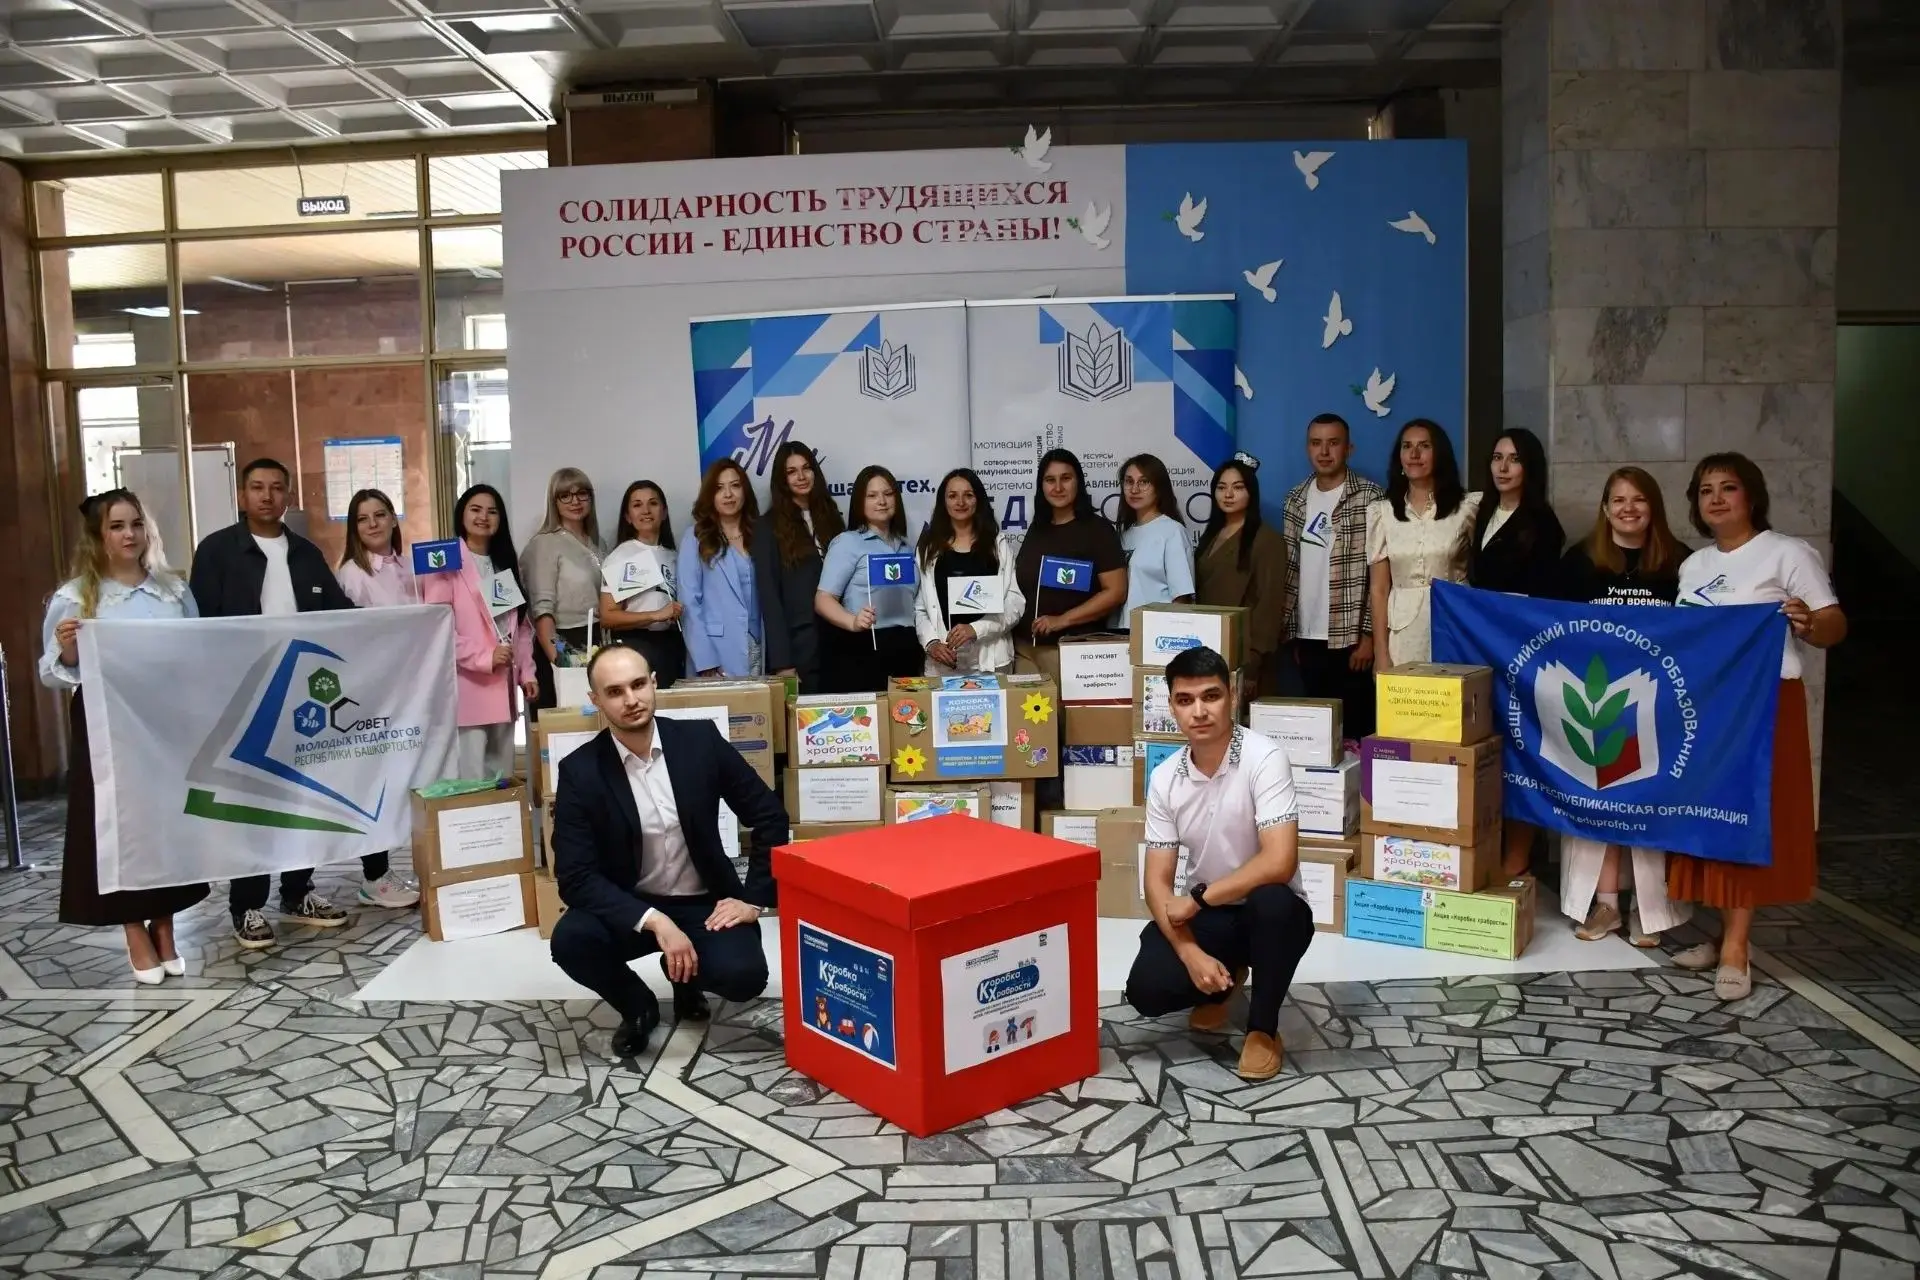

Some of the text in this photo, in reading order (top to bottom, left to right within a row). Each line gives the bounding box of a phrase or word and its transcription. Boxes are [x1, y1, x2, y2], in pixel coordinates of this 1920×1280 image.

[302, 199, 346, 212] ВЫХОД
[559, 181, 1069, 225] СОЛИДАРНОСТЬ ТРУДЯЩИХСЯ
[559, 231, 695, 259] РОССИИ
[722, 221, 903, 257] ЕДИНСТВО
[912, 216, 1061, 244] СТРАНЫ!
[972, 468, 1033, 478] оммуникация
[983, 459, 1033, 467] сотворчество
[1607, 586, 1653, 597] Учитель
[1507, 619, 1698, 779] ОБЩЕРССИЙСКИЙ ПРОФСОЮЗ ОБРАЗОВАНИЯ
[294, 738, 423, 766] РЕСПУБЛИКИ БАШКОРТОСТАН
[295, 726, 421, 754] МОЛОДЫХ ПЕДАГОГОВ
[807, 745, 873, 756] храбрости
[1503, 771, 1749, 826] СКАЯ РЕСПУБЛИКАНСКАЯ ОРГАНИЗАЦИЯ
[1553, 806, 1647, 831] www.eduprofrb.ru
[1384, 857, 1451, 871] храбрости
[819, 959, 858, 982] Коробка
[826, 971, 867, 1002] Храбрости
[979, 970, 1021, 1002] Коробка
[988, 981, 1031, 1002] Храбрости
